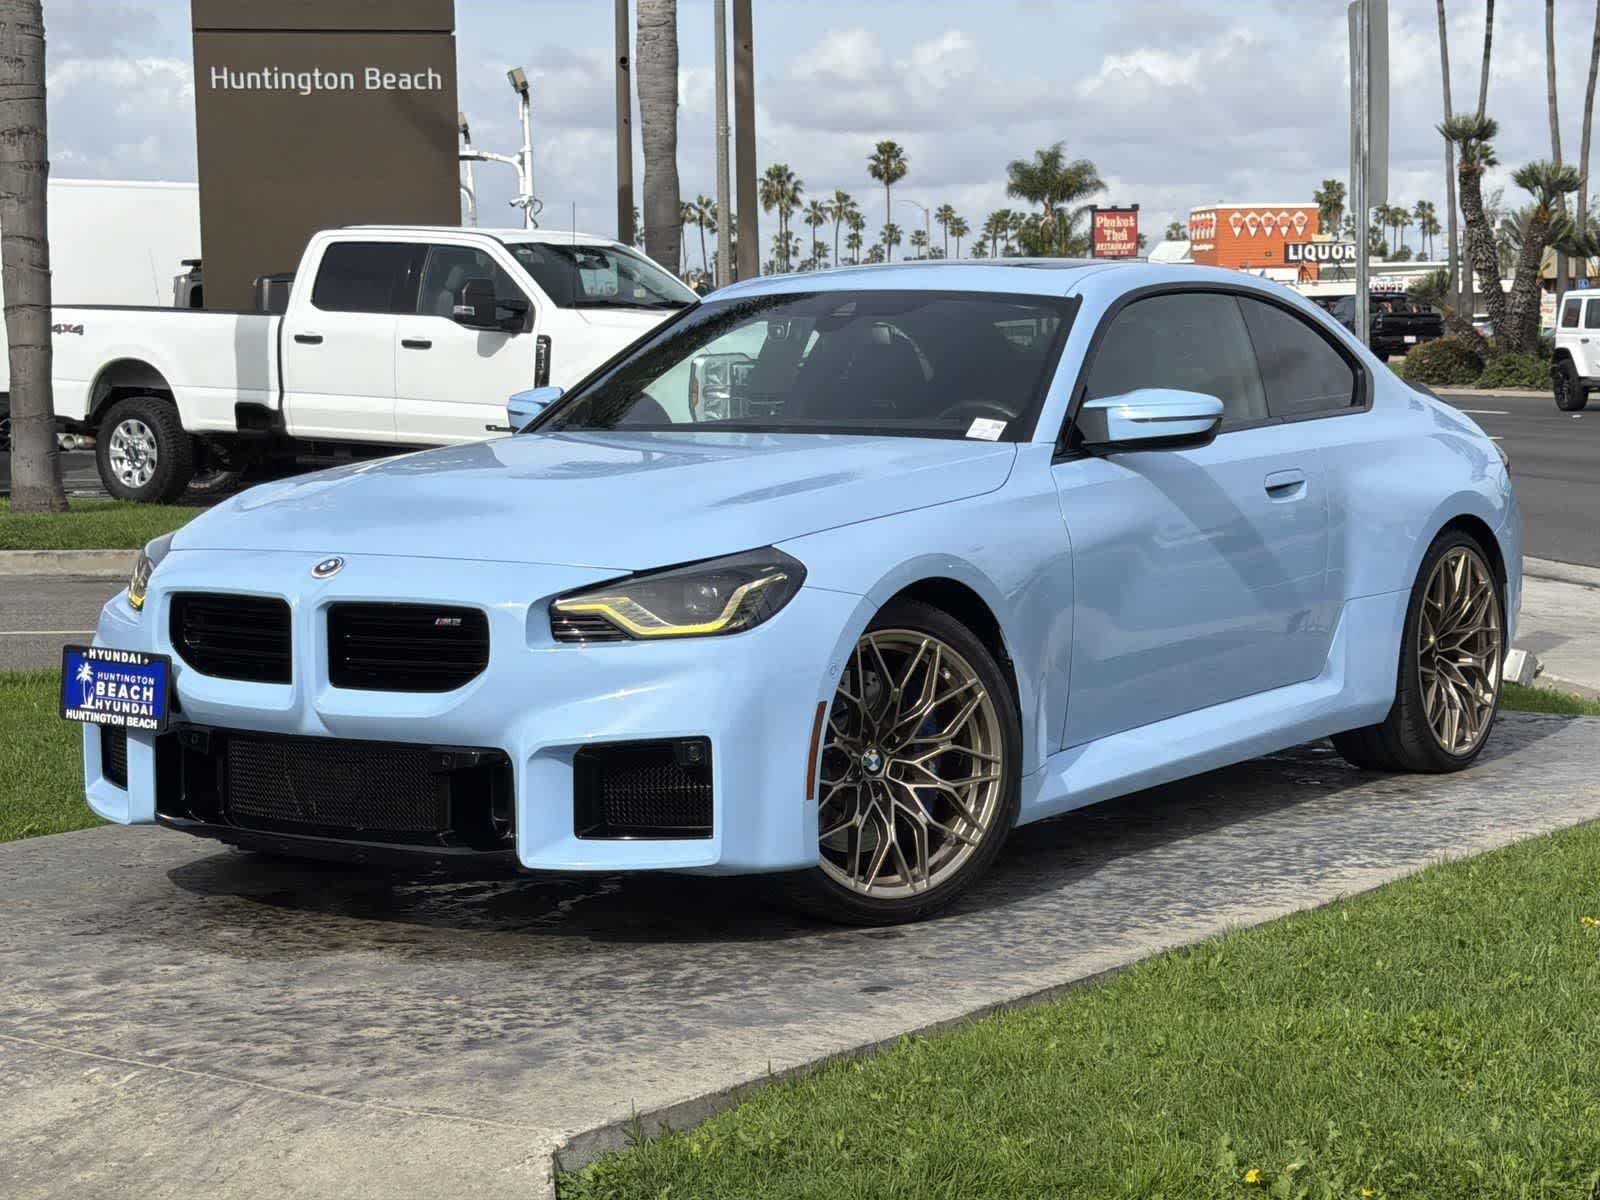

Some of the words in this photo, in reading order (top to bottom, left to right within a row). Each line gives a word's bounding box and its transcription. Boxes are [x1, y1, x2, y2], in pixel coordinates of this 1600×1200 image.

[210, 66, 354, 95] Huntington
[364, 67, 442, 90] Beach
[1288, 244, 1357, 261] LIQUOR
[89, 649, 141, 664] HYUNDAI
[97, 672, 154, 685] HUNTINGTON
[96, 682, 153, 701] BEACH
[95, 700, 153, 715] HYUNDAI
[66, 710, 124, 725] HUNTINGTON
[126, 716, 157, 729] BEACH
